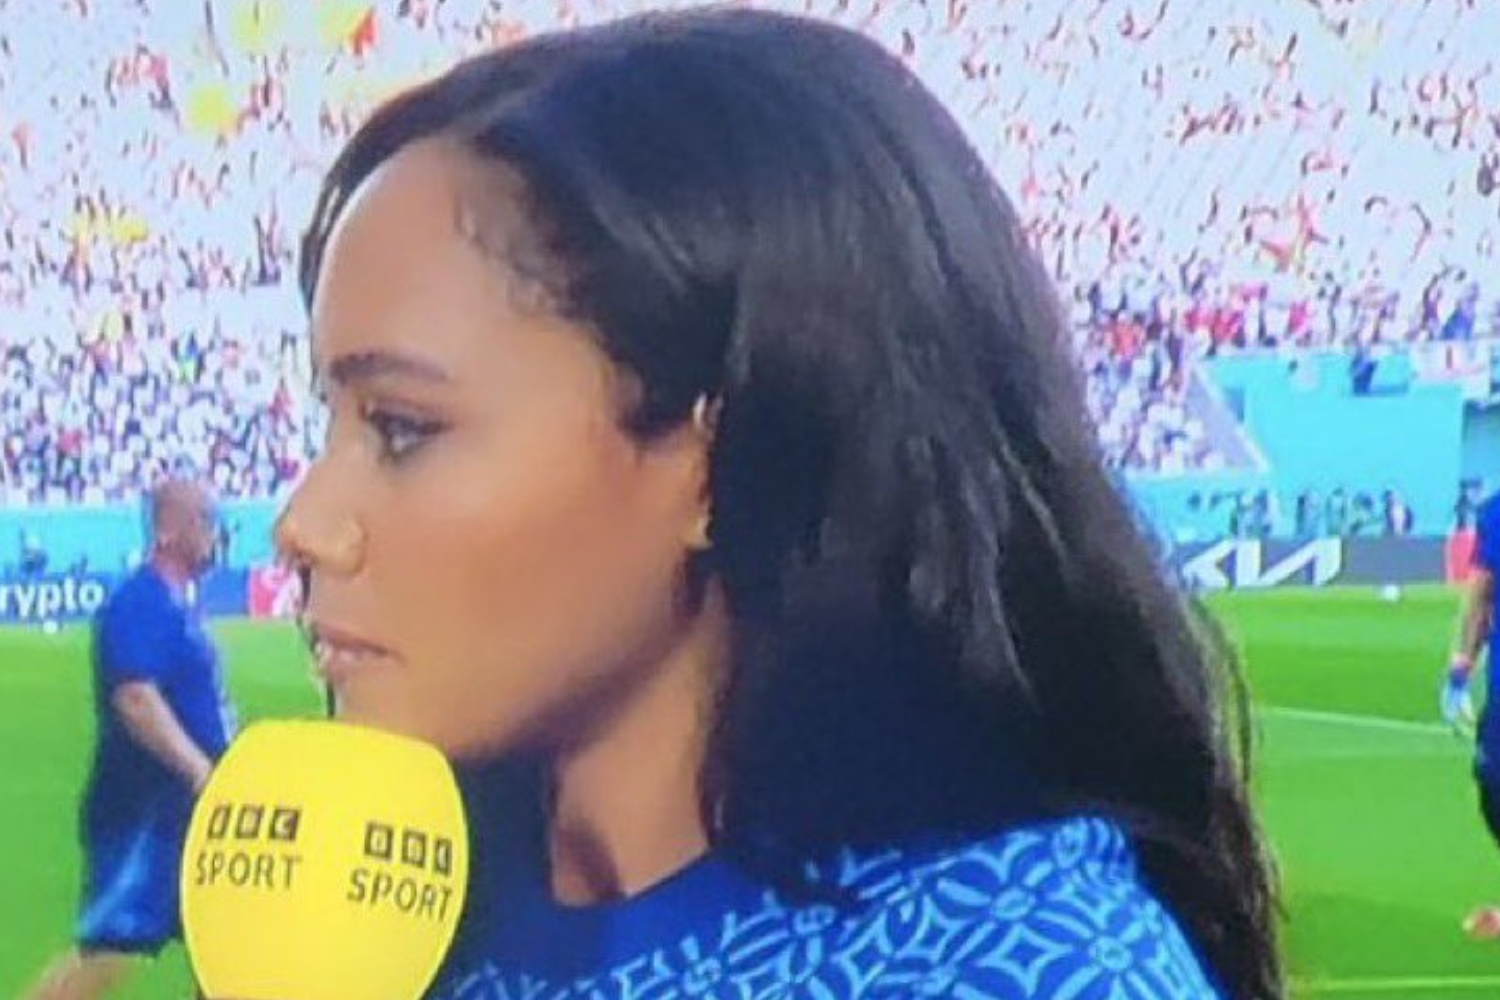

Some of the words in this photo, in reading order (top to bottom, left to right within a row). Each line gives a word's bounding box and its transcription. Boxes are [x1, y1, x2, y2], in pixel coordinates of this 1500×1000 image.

[0, 577, 105, 619] rypto
[196, 852, 302, 889] SPORT
[346, 867, 453, 921] SPORT
